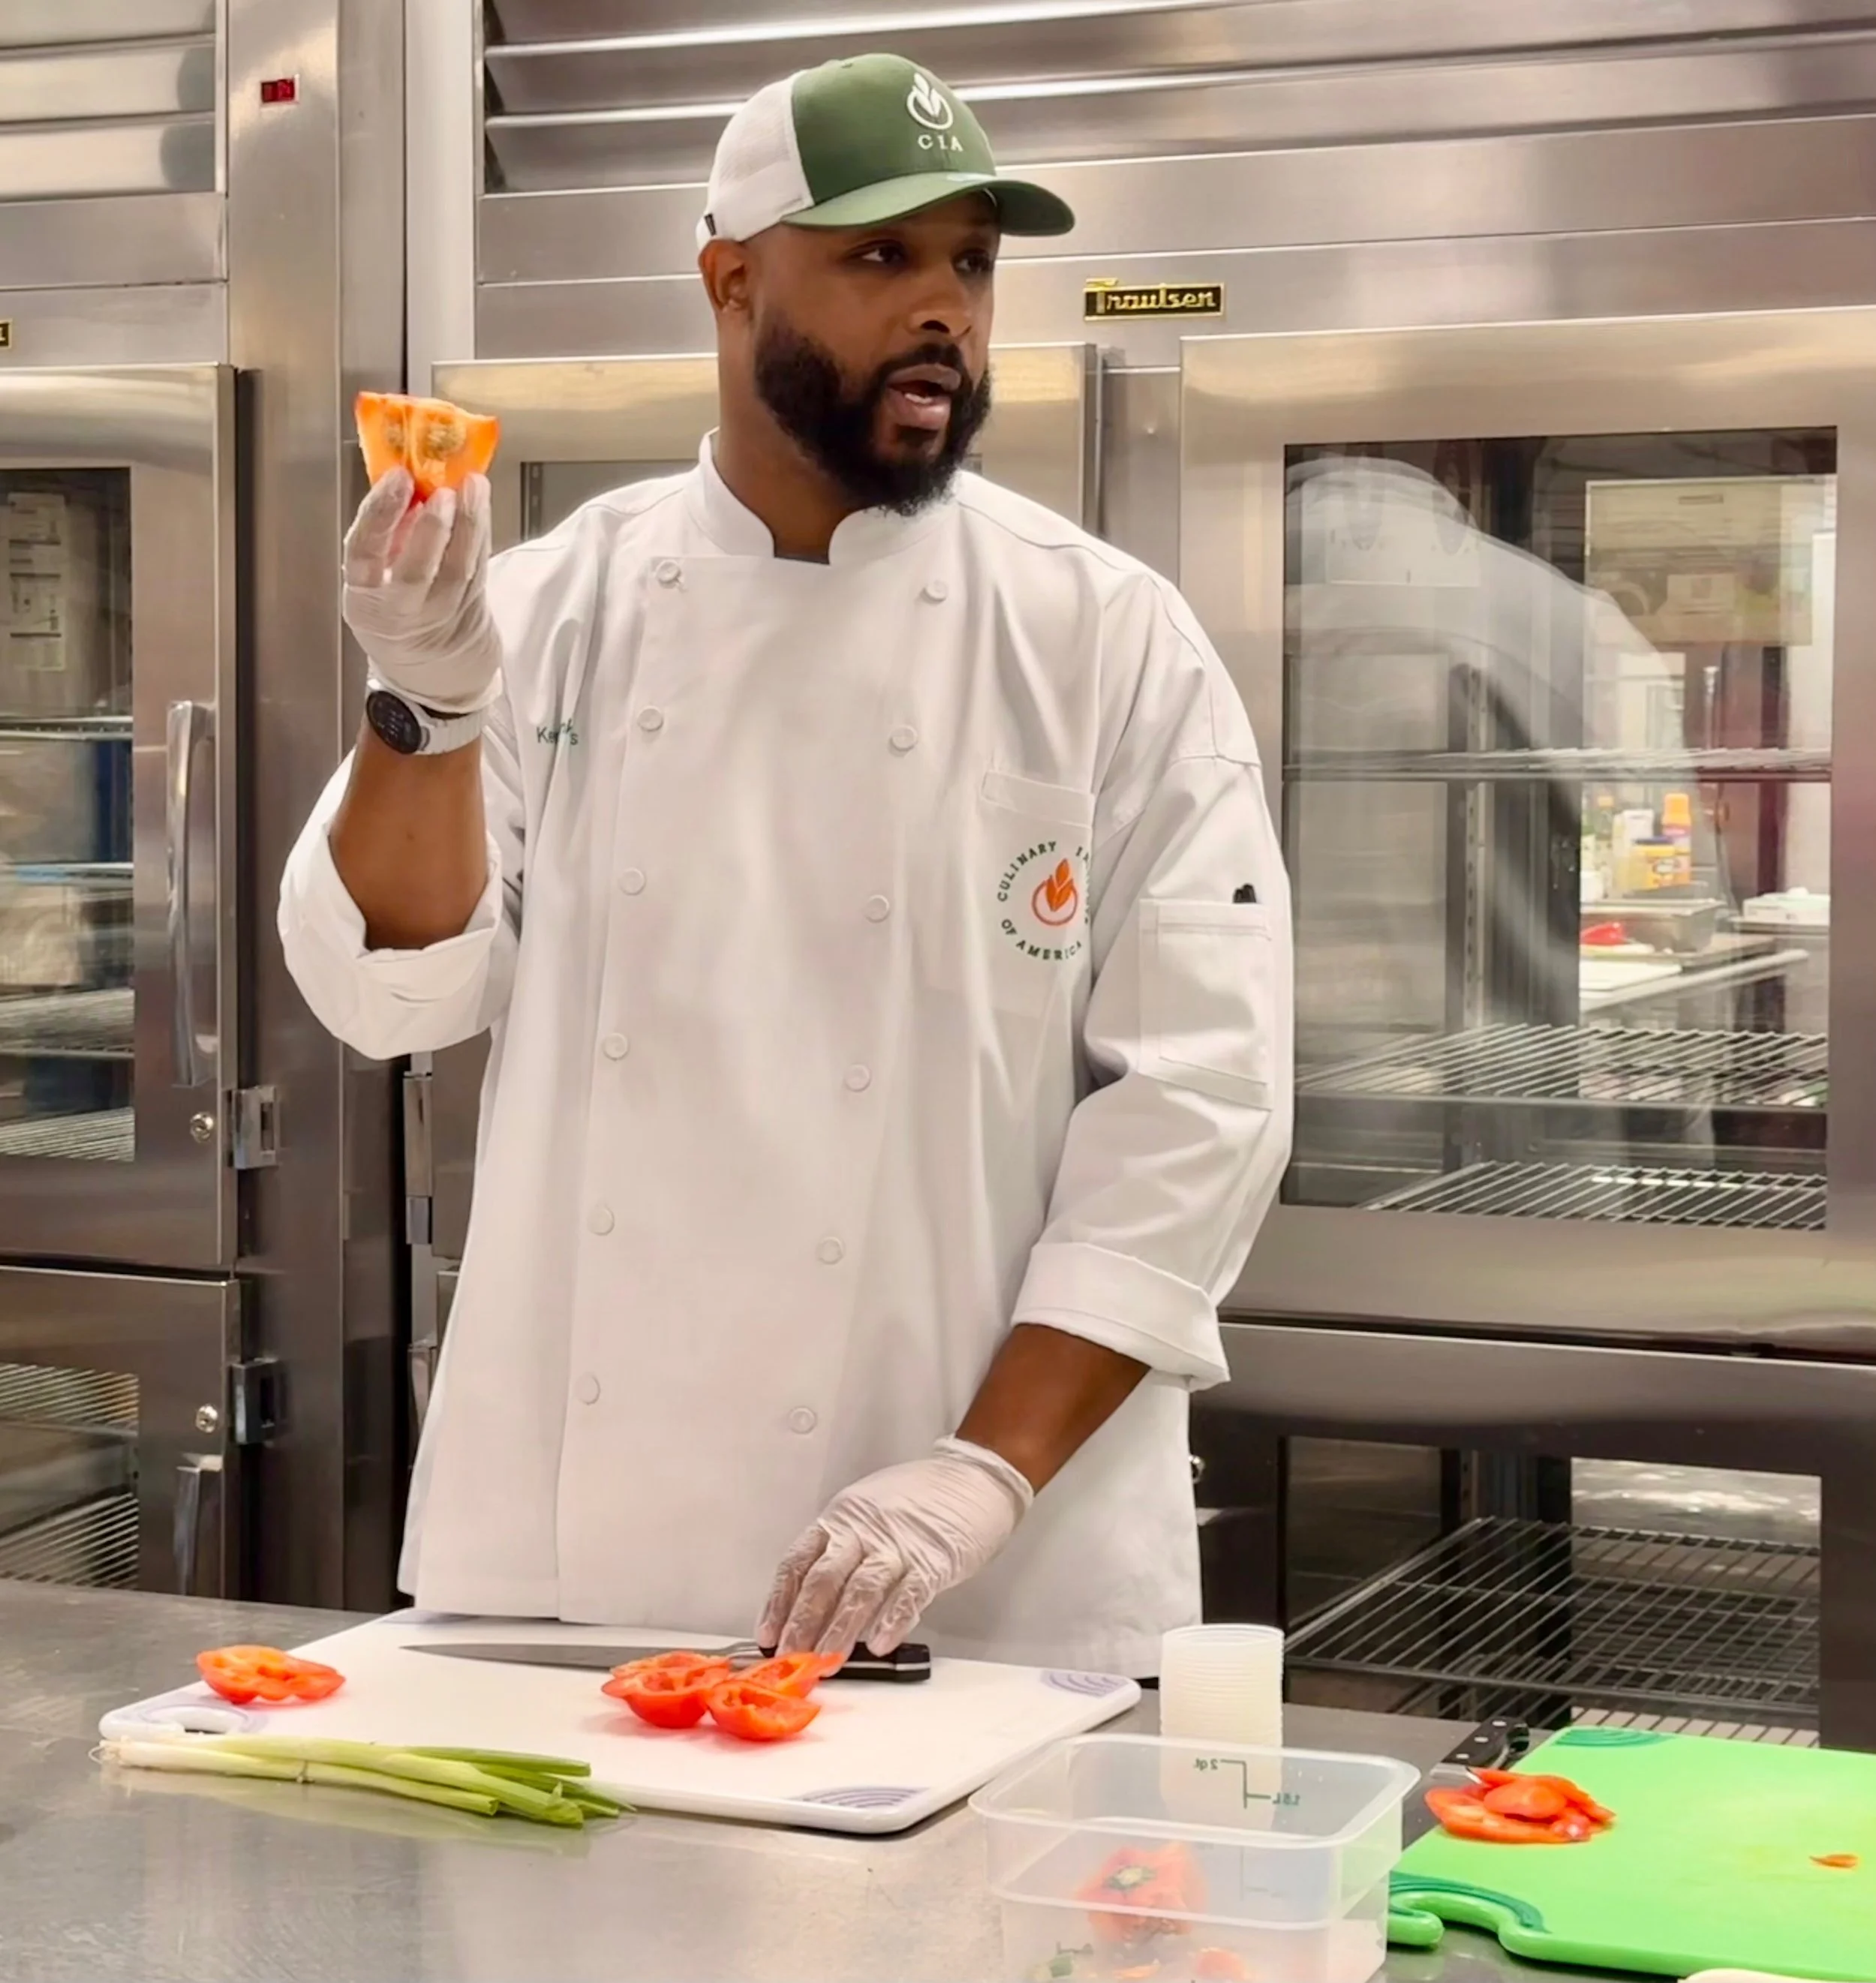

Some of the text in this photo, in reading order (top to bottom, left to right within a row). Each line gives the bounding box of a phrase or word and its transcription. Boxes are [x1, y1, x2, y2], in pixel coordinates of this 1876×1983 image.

[918, 134, 964, 152] CIA
[1086, 278, 1216, 314] Traulsen
[997, 840, 1057, 903] CULINARY
[1001, 918, 1018, 936] OF
